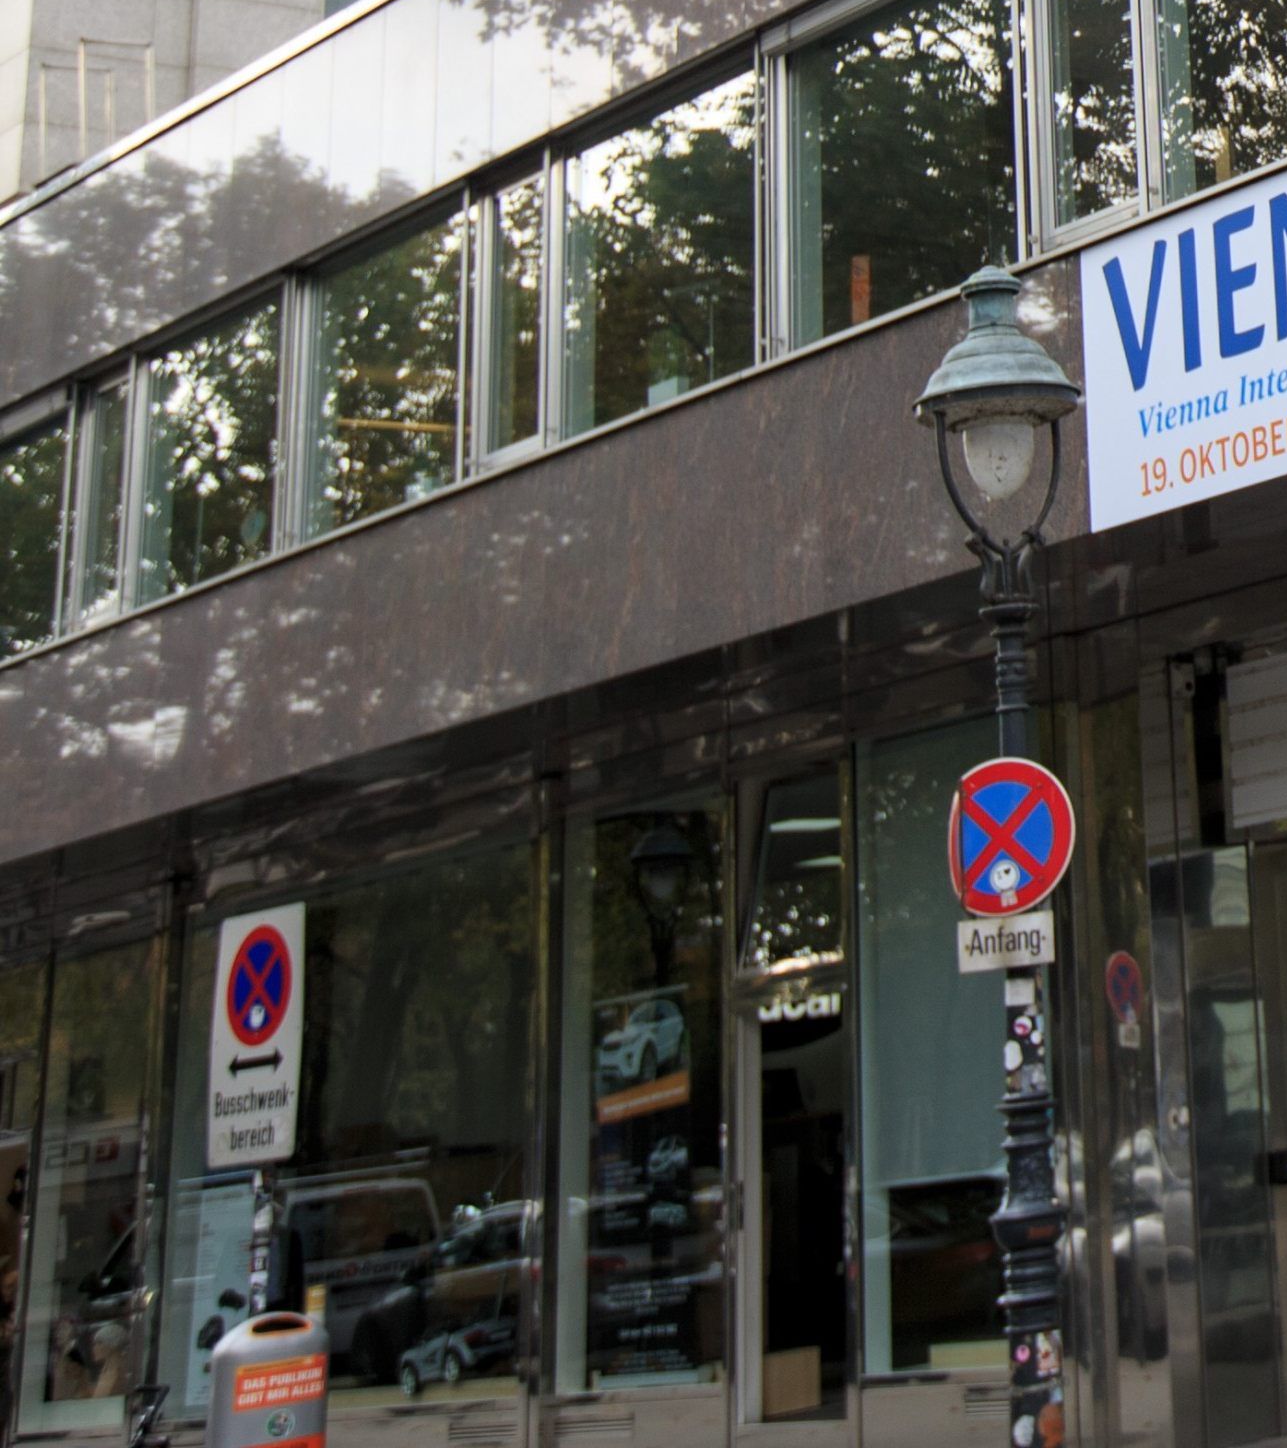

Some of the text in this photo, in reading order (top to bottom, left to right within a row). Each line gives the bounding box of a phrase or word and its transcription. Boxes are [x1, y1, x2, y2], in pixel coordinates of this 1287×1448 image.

[1138, 382, 1229, 437] Vienna
[969, 928, 1042, 958] Anfang
[215, 1081, 294, 1118] Busschwenk-
[230, 1121, 274, 1151] bereich
